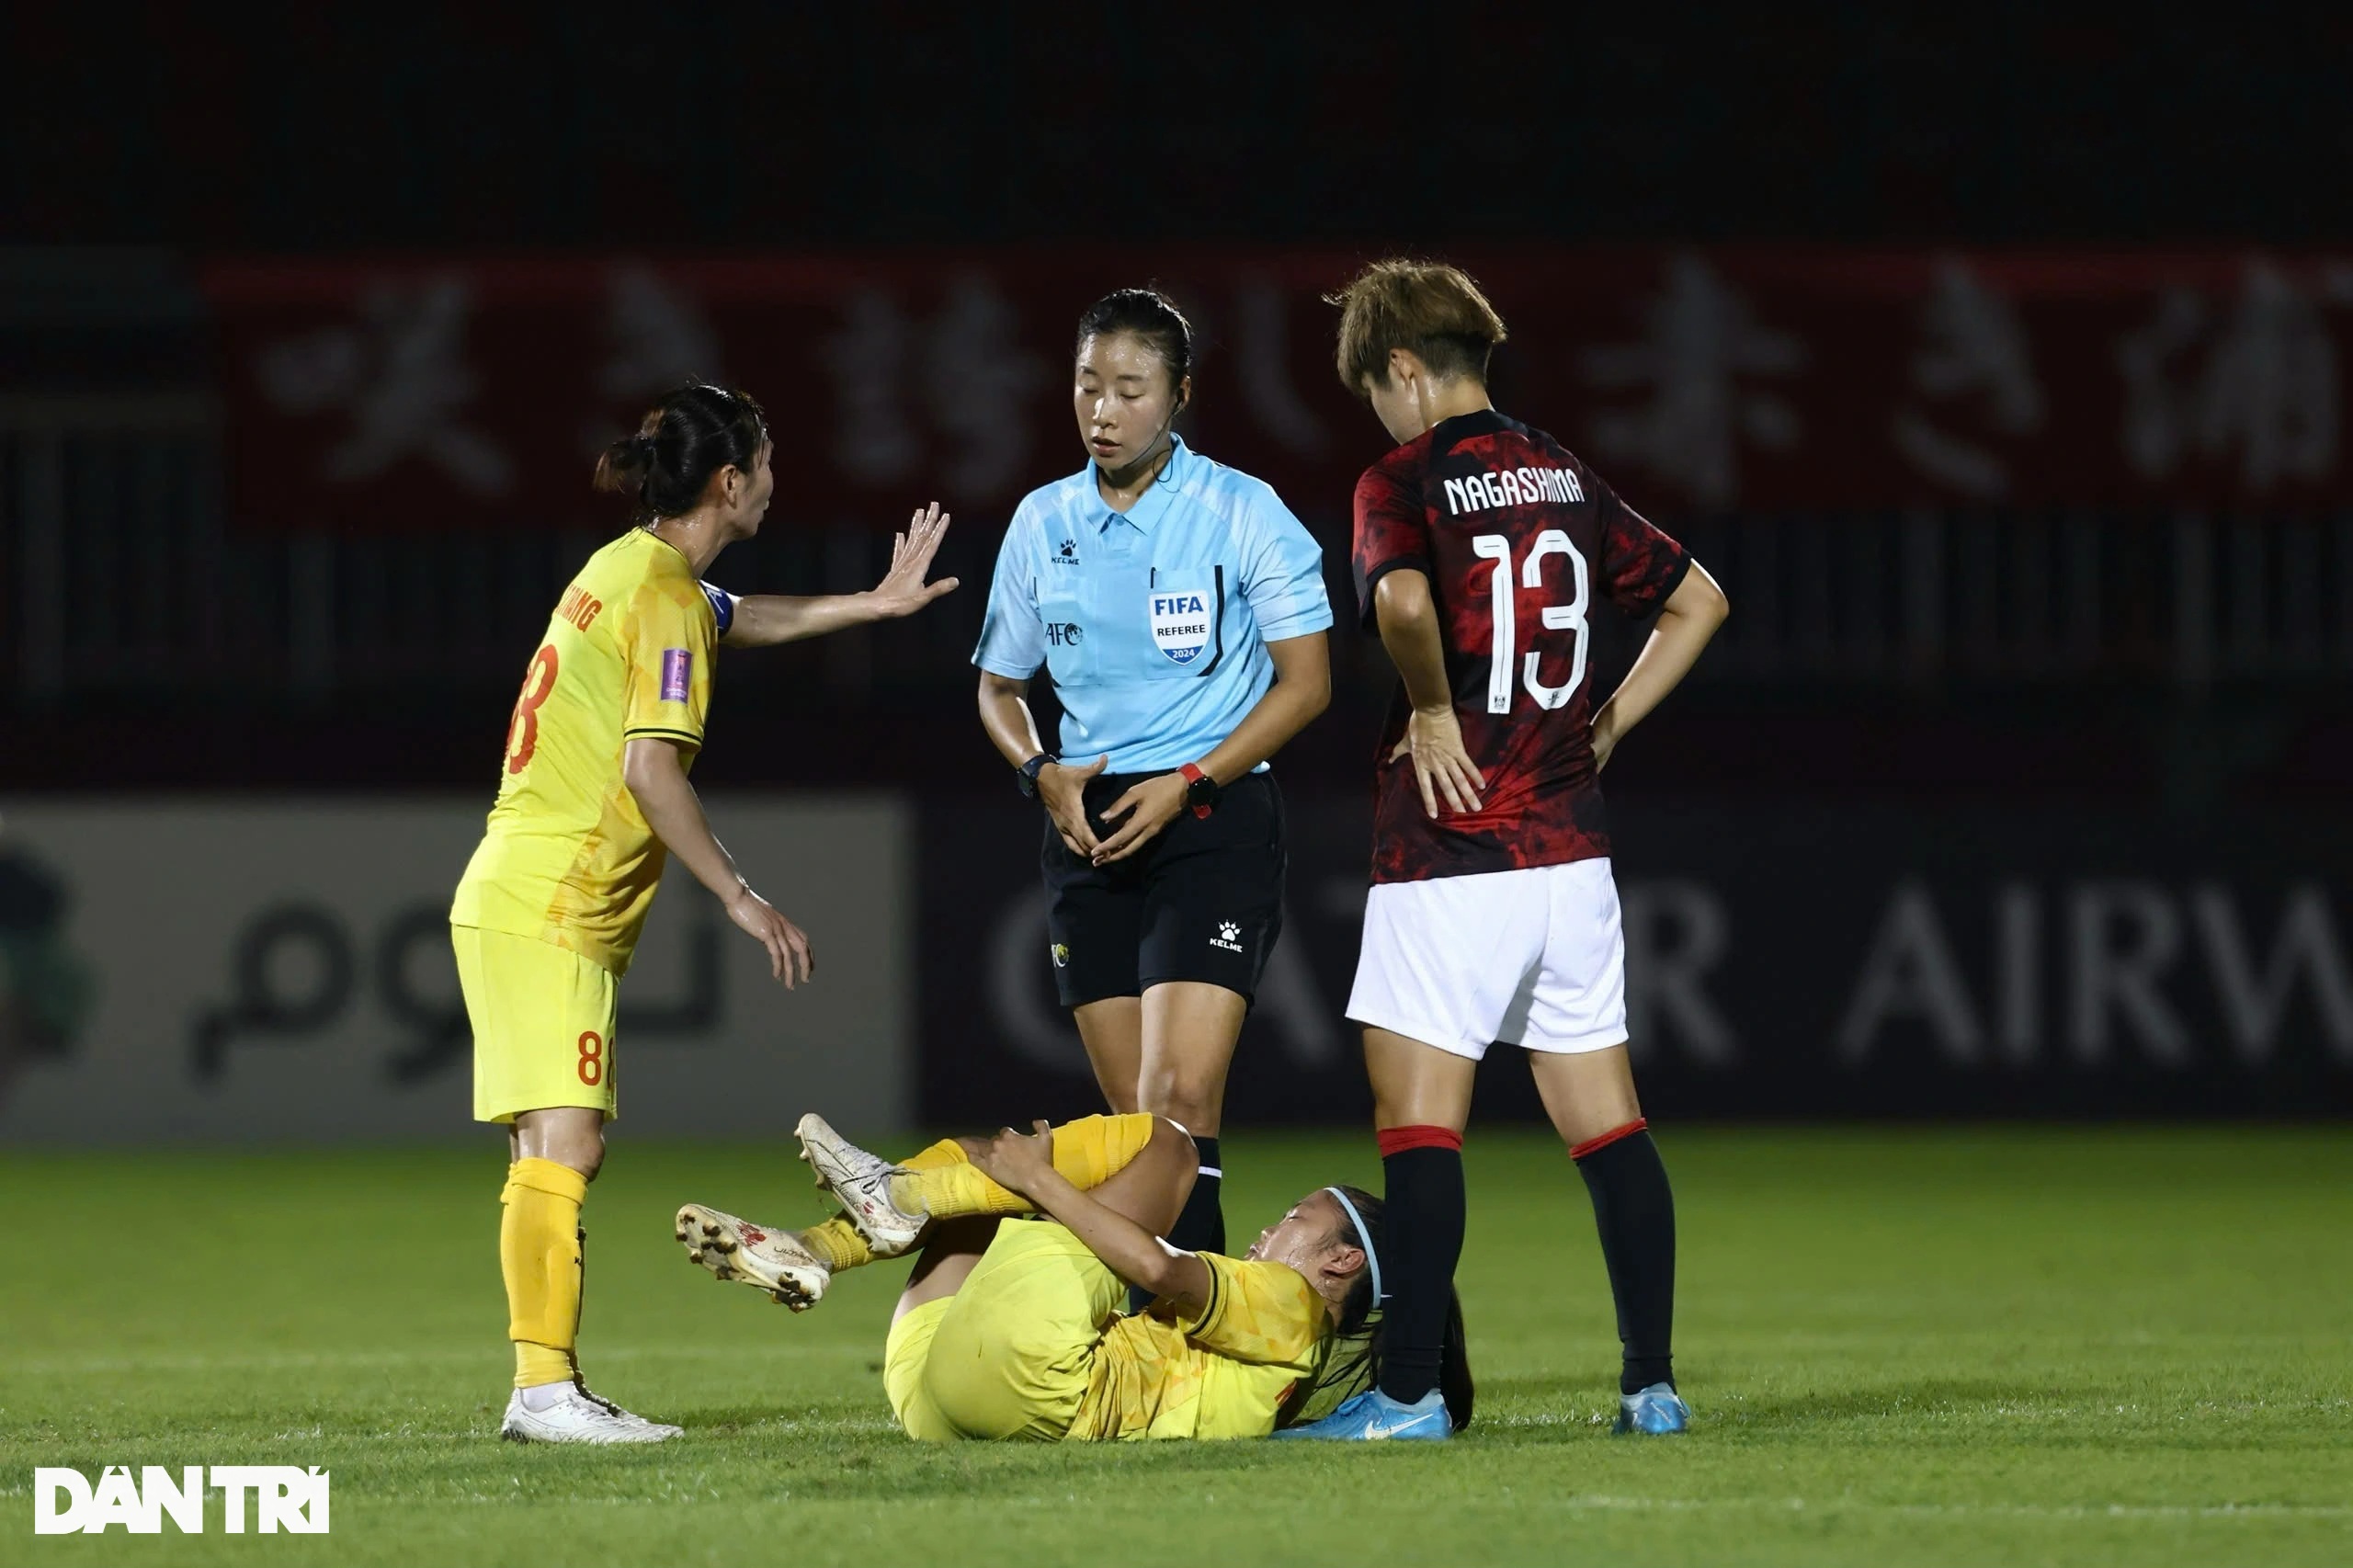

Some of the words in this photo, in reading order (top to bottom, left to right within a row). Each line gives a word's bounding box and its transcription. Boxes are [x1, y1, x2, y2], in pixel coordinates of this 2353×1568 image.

[1444, 467, 1586, 515] NAGASHIMA
[1051, 556, 1080, 566] KELME
[1154, 596, 1204, 617] FIFA
[1156, 623, 1206, 638] REFEREE
[1472, 529, 1589, 715] 13
[1045, 622, 1083, 646] AFC
[1172, 648, 1196, 660] 2024
[506, 644, 559, 774] 8
[1210, 937, 1243, 954] KELME
[578, 1030, 602, 1086] 8
